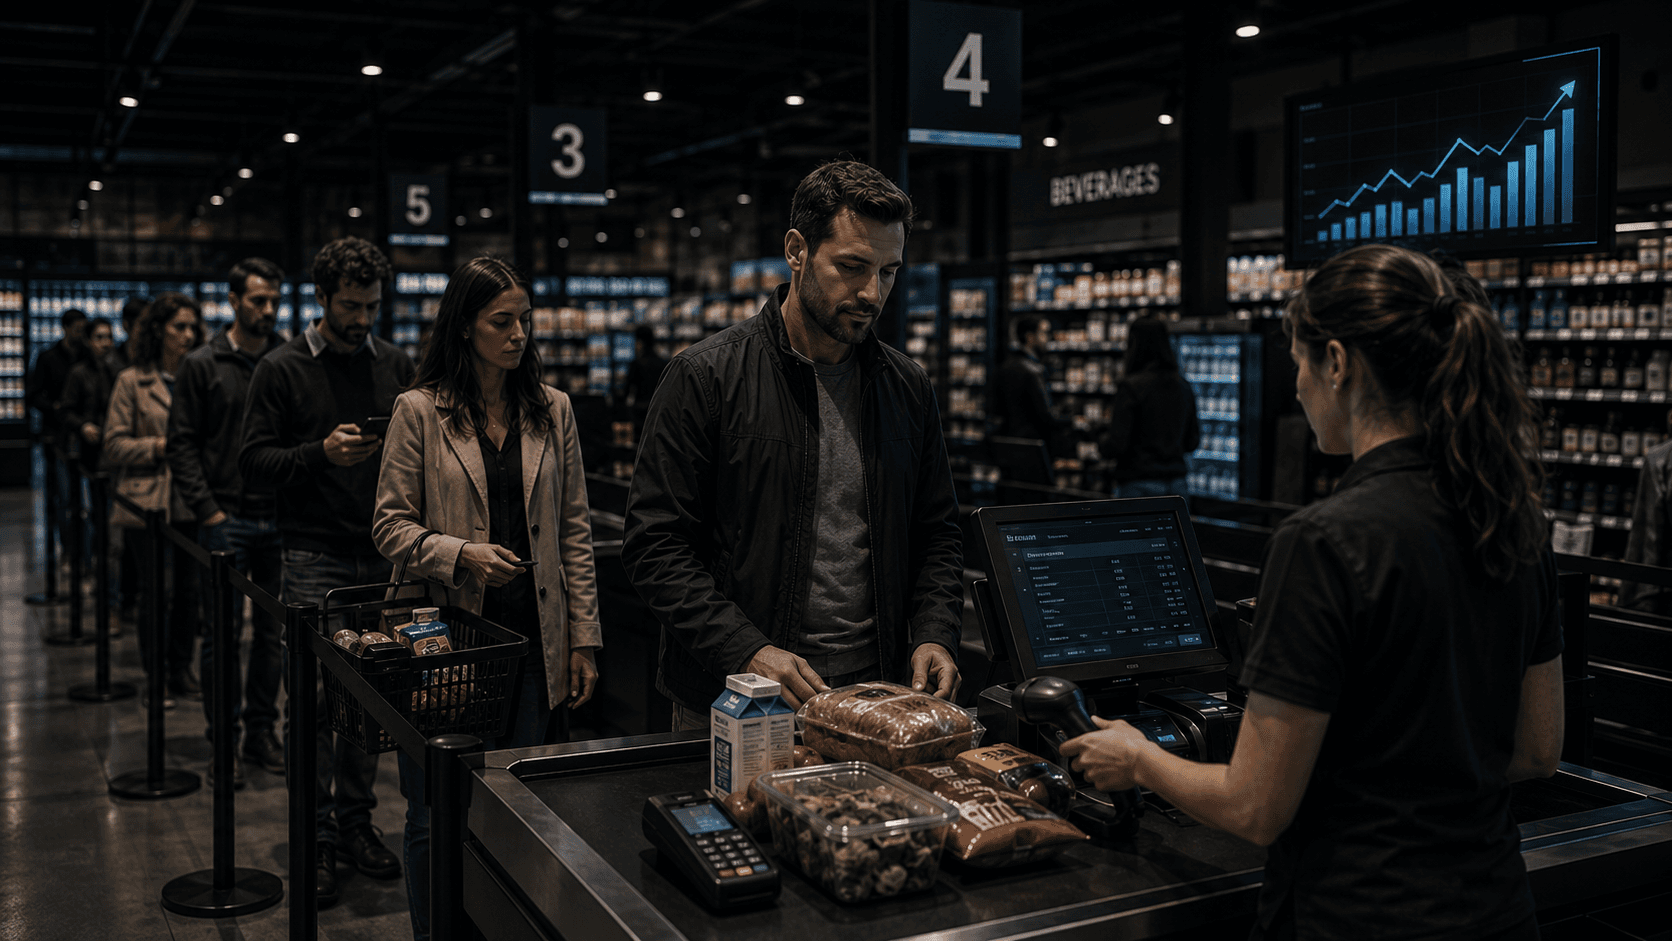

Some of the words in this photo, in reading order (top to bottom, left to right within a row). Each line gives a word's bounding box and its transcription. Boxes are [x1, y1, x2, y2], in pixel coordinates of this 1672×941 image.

[943, 32, 990, 108] 4
[551, 123, 585, 178] 3
[405, 185, 431, 226] 5
[1050, 163, 1160, 207] BEVERAGES
